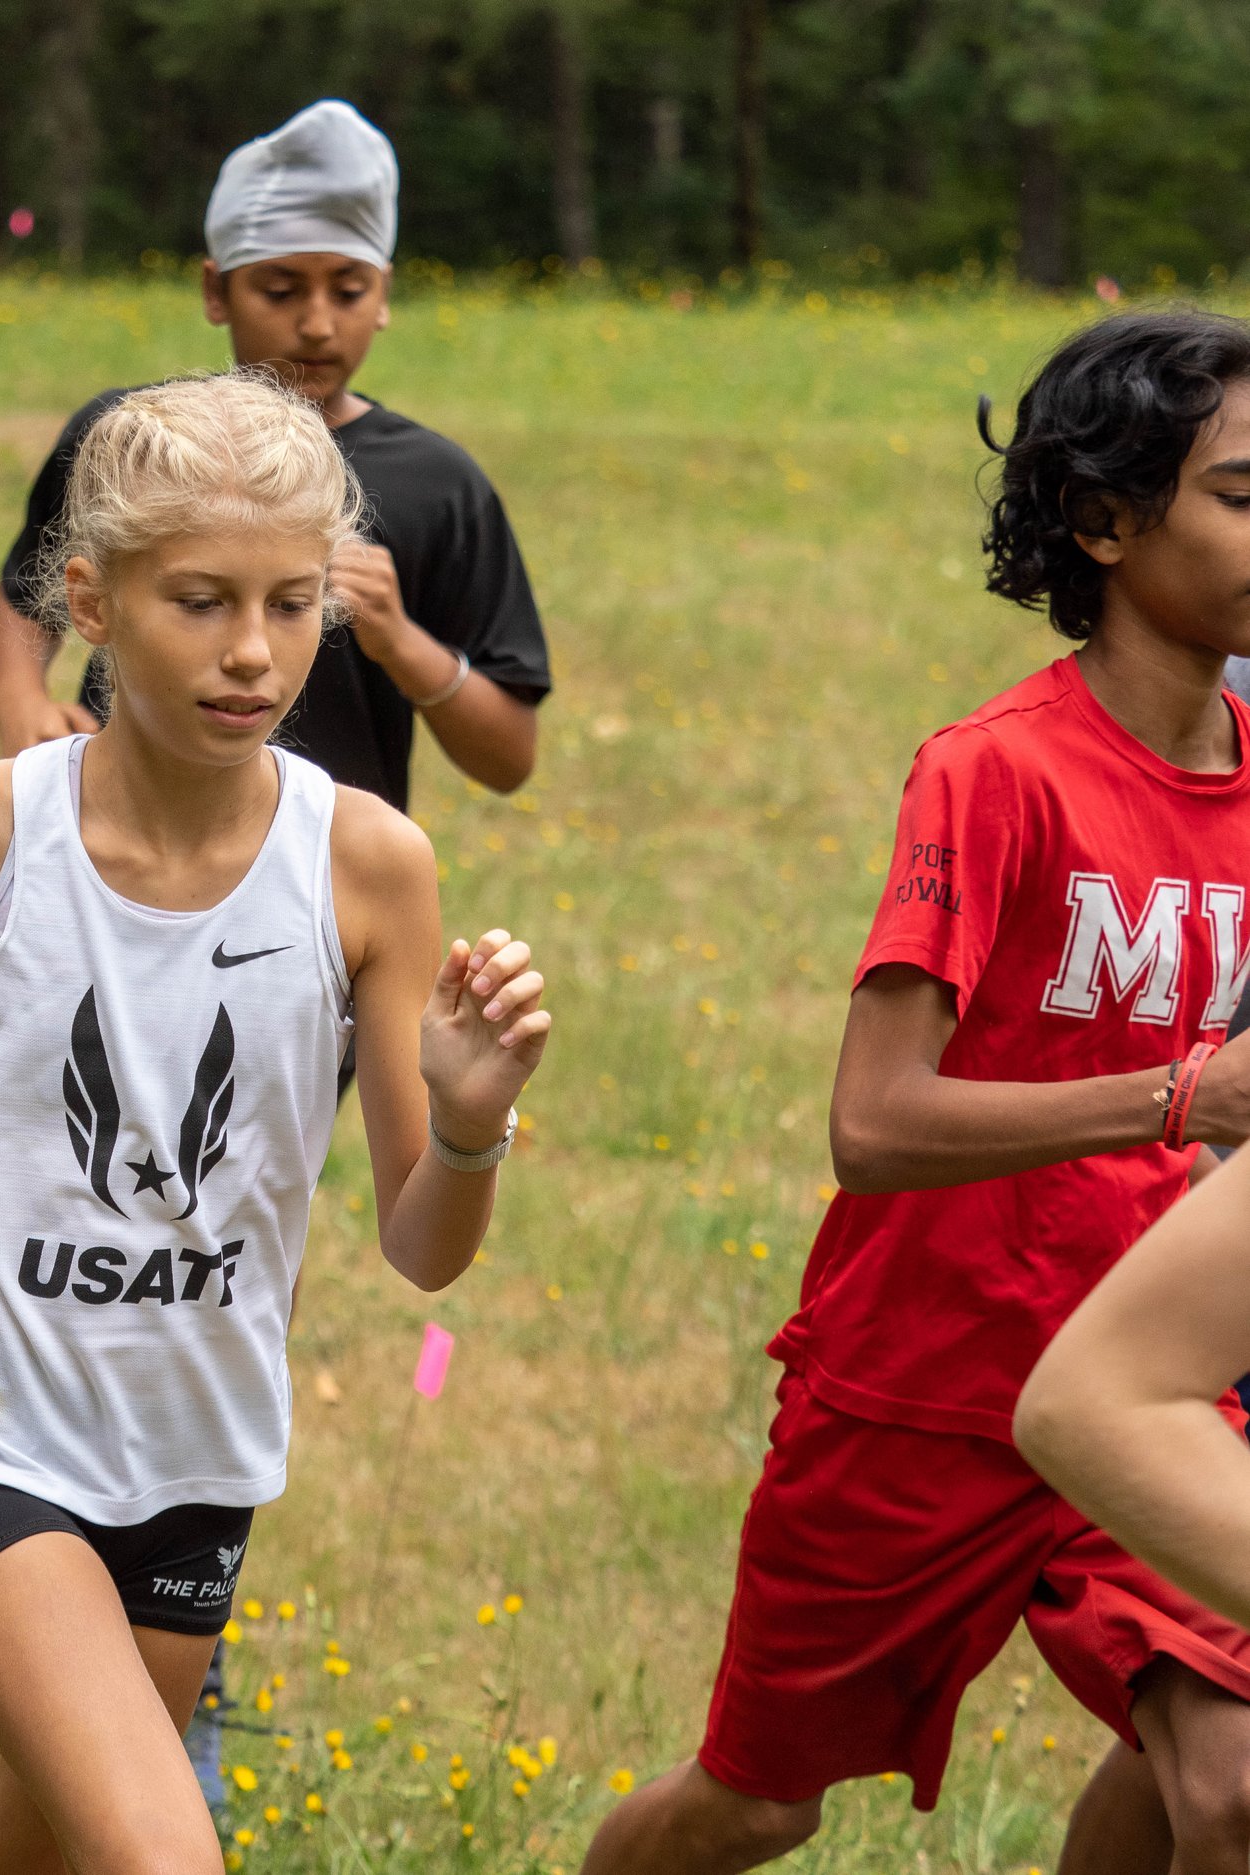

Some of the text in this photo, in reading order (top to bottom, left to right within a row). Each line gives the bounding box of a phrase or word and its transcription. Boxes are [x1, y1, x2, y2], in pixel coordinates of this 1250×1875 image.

[1174, 1090, 1188, 1111] Field
[1182, 1068, 1196, 1090] Clinic
[17, 1237, 245, 1308] USATF
[152, 1577, 197, 1597] THE
